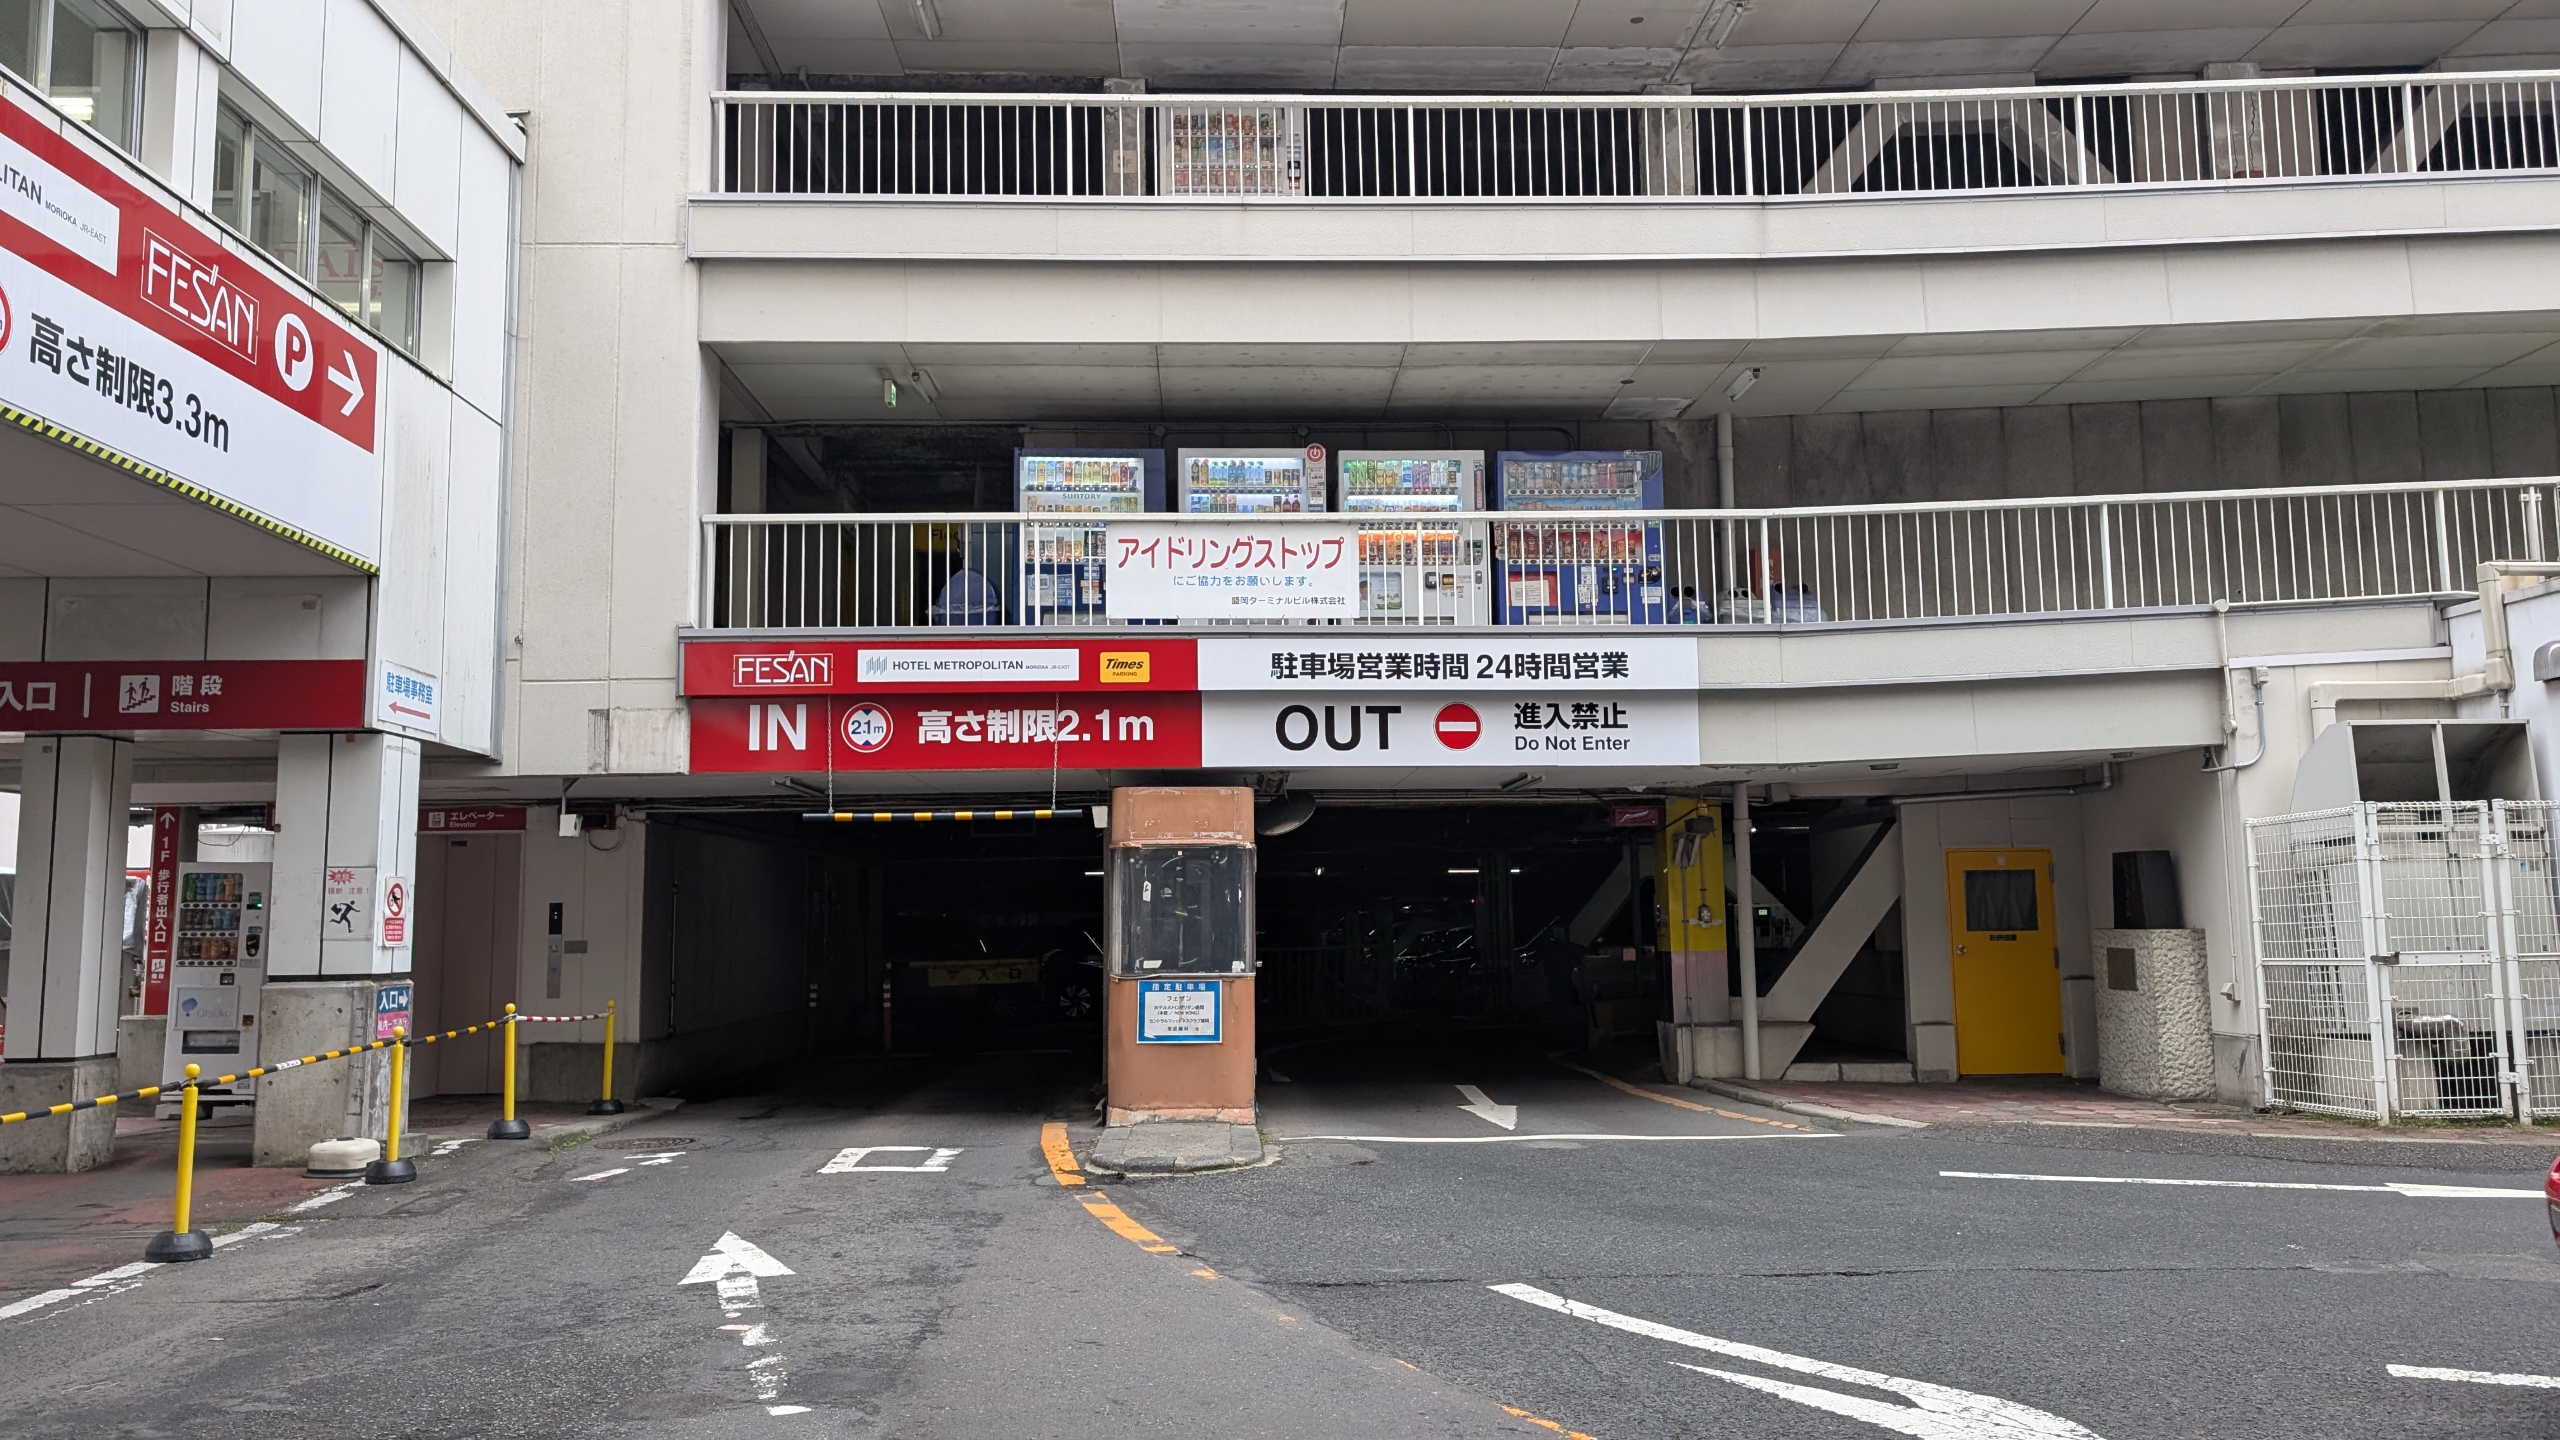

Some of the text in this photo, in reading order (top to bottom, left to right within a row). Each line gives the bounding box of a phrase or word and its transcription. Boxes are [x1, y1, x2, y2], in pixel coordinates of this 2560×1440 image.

[0, 163, 108, 245] ITAN MORIOKA JR-EAST
[146, 238, 308, 379] FESAN P
[29, 311, 231, 453] 高さ制限3.3m
[1117, 534, 1345, 570] アイドリングストップ
[1173, 574, 1315, 587] にご協力をお願いします。
[1231, 596, 1346, 606] 盛岡ターミナルビル株式会社
[737, 650, 829, 684] FESAN
[892, 660, 931, 671] HOTEL
[933, 659, 1024, 671] METROPOLITAN
[1105, 658, 1145, 670] Times
[1270, 651, 1630, 680] 駐車場営業時間 24時間営業
[171, 674, 223, 697] 階段
[386, 671, 433, 705] 駐車場事務室
[170, 701, 210, 713] Stairs
[1514, 702, 1629, 730] 進入禁止
[748, 703, 807, 751] IN
[850, 719, 885, 735] 2.1m
[917, 708, 1155, 744] 高さ制限2.1m
[1275, 704, 1402, 751] OUT
[1515, 735, 1631, 751] Do Not Enter
[450, 811, 505, 821] エレベーター
[154, 868, 171, 943] 歩行者出入口
[379, 991, 398, 1011] 入口
[1152, 983, 1206, 991] 指定駐車場
